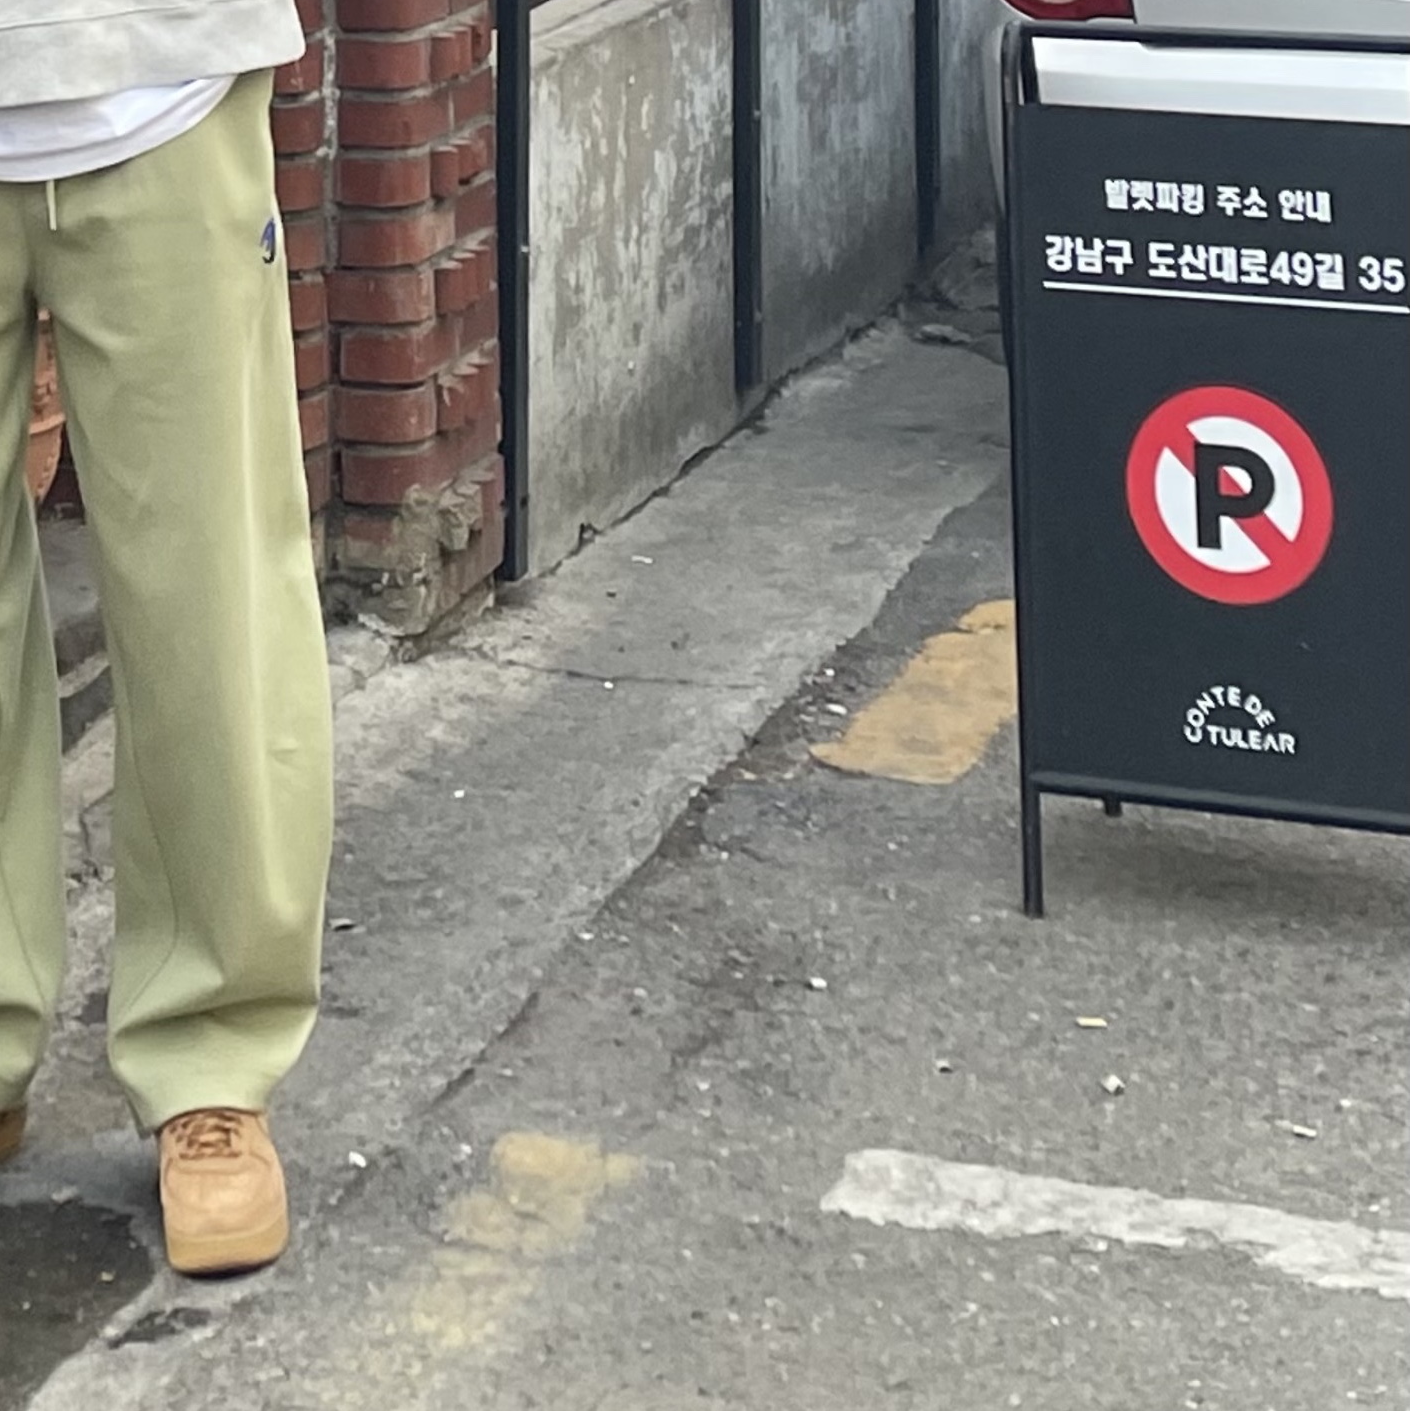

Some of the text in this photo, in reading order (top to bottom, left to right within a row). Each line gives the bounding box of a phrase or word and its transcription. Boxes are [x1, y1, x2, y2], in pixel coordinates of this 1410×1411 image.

[1104, 178, 1332, 223] 발렛파킹 주소 안내
[1044, 234, 1406, 293] 강남구 도산대로49길 35
[1183, 684, 1276, 744] CONTE DE
[1206, 724, 1295, 755] TULEAR
